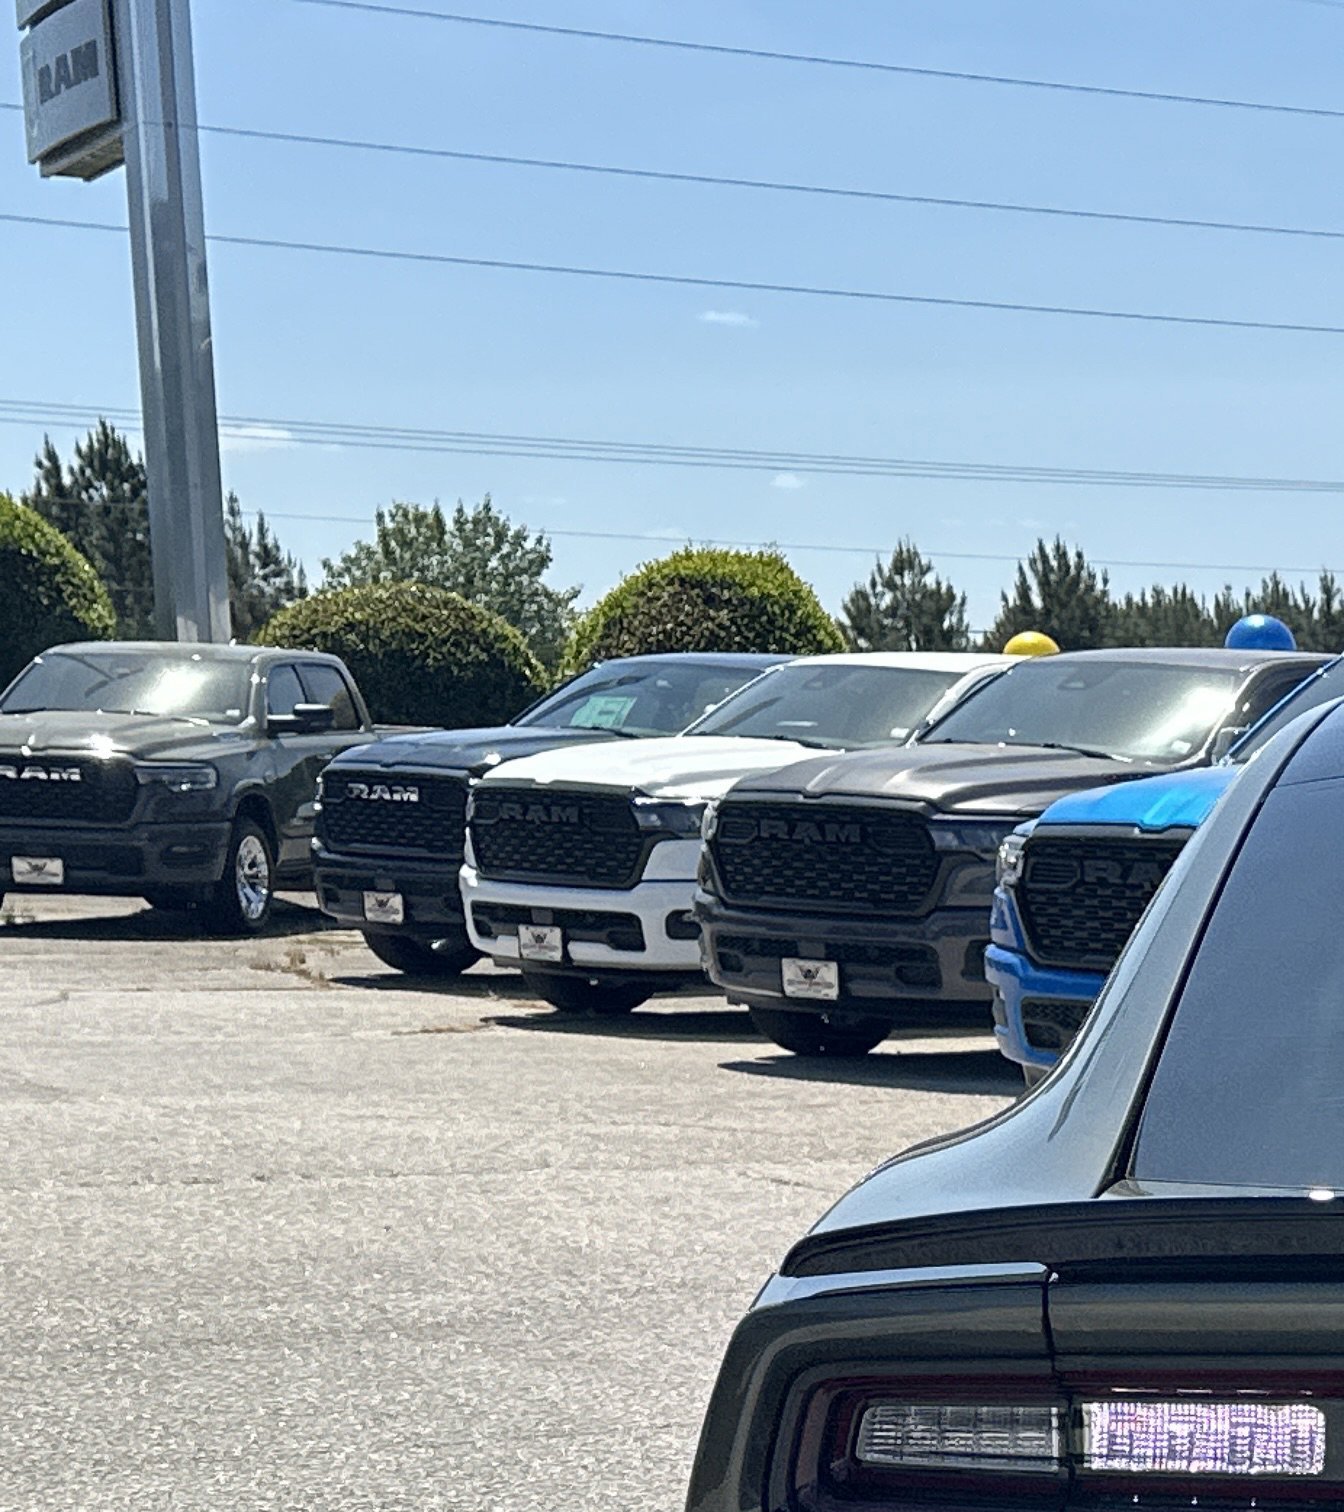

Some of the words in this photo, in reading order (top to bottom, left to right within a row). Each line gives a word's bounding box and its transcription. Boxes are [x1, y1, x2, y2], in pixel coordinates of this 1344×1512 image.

[38, 40, 99, 105] RAM
[346, 782, 419, 802] RAM
[502, 802, 579, 823] RAM
[759, 818, 861, 843] RAM
[1083, 859, 1163, 888] RA
